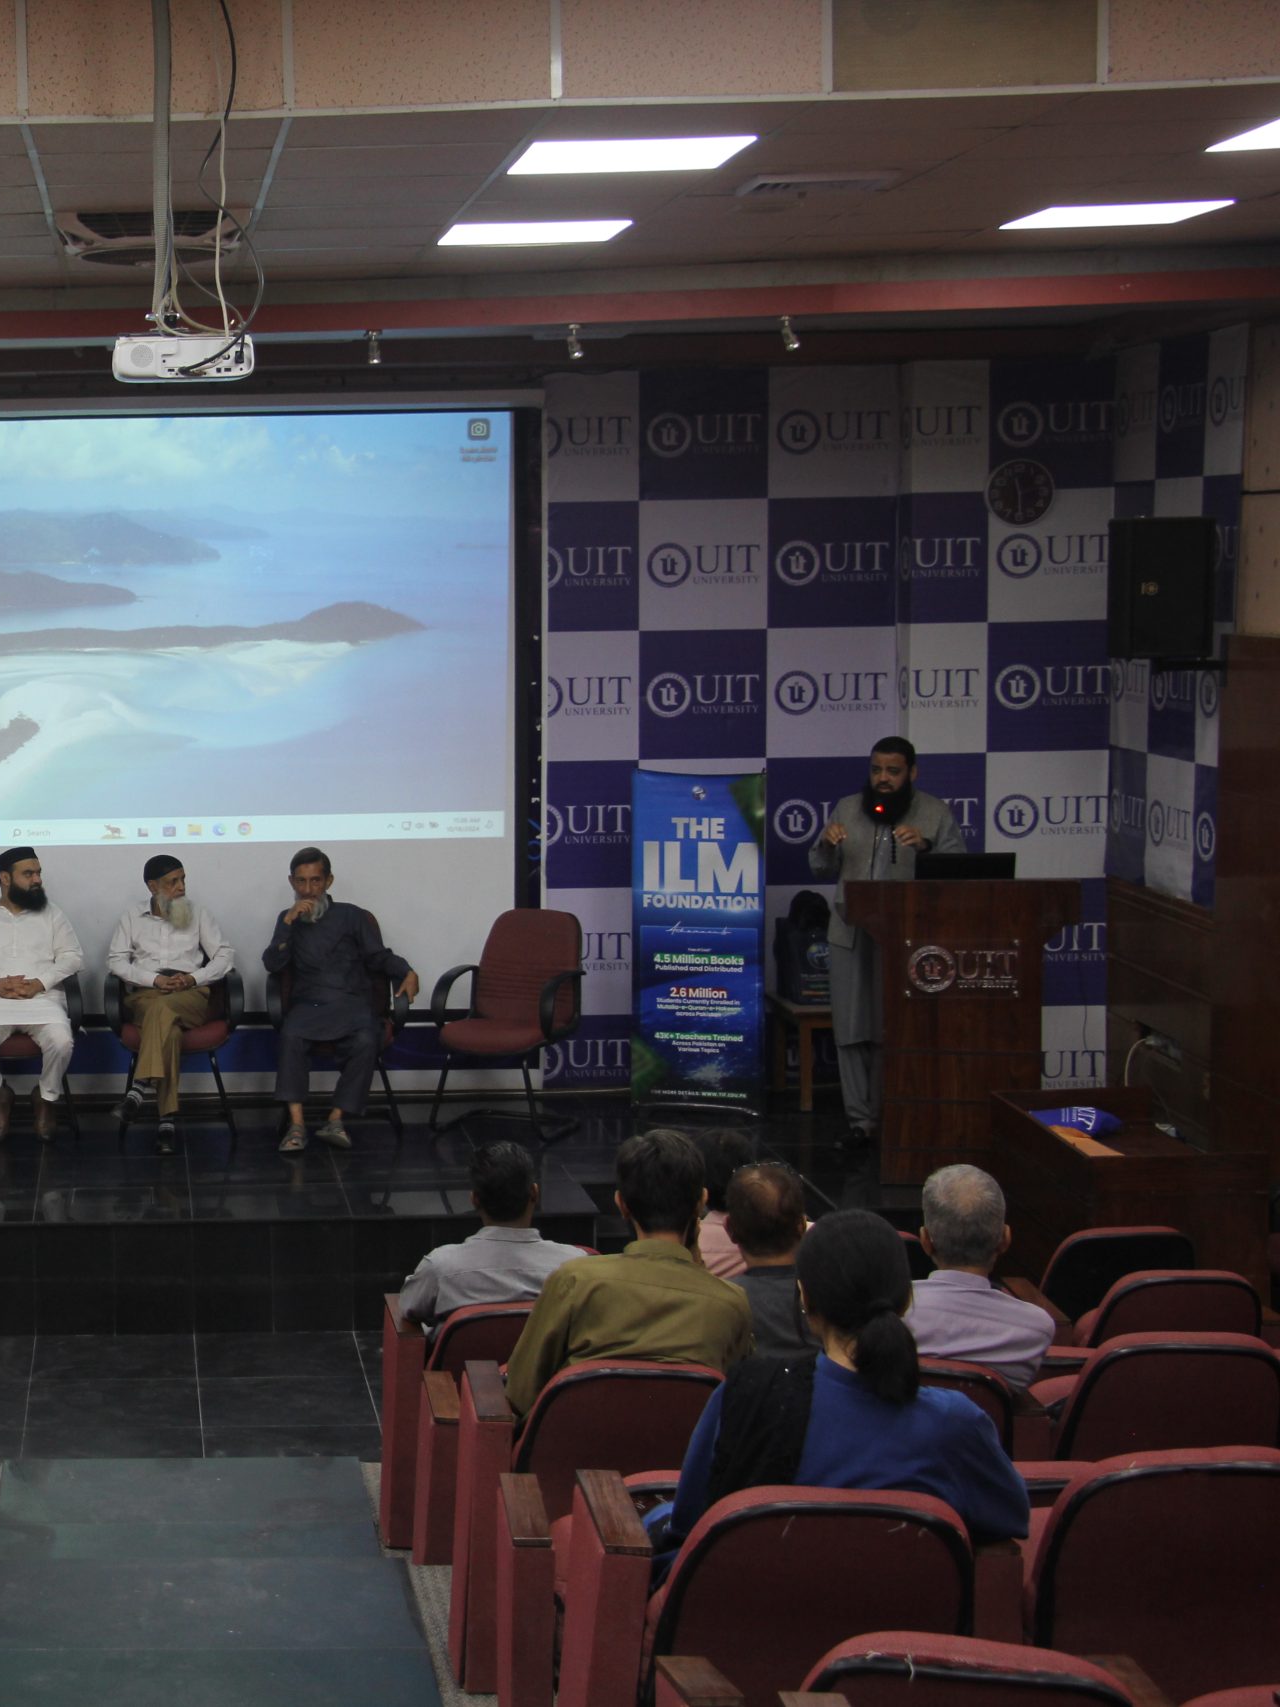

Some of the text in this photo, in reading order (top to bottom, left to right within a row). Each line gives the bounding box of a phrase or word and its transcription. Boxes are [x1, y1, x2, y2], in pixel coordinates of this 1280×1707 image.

[564, 416, 631, 446] UIT
[694, 414, 760, 443] UIT
[824, 411, 890, 440] UIT
[912, 406, 981, 436] UIT
[1044, 402, 1117, 432] UIT
[564, 547, 631, 575] UIT
[694, 545, 760, 573] UIT
[822, 542, 889, 571] UIT
[912, 538, 981, 567] UIT
[564, 577, 631, 586] UNIVERSITY
[693, 575, 760, 584] UNIVERSITY
[821, 573, 888, 582] UNIVERSITY
[912, 568, 981, 578] UNIVERSITY
[565, 677, 631, 705] UIT
[693, 674, 760, 703] UIT
[822, 672, 888, 701] UIT
[912, 668, 980, 698] UIT
[1043, 665, 1112, 695] UIT
[564, 707, 632, 716] UNIVERSITY
[692, 705, 759, 714] UNIVERSITY
[820, 703, 887, 712] UNIVERSITY
[911, 700, 979, 709] UNIVERSITY
[1042, 697, 1112, 706] UNIVERSITY
[564, 805, 631, 834] UIT
[1042, 796, 1109, 824] UIT
[26, 828, 51, 838] Search
[564, 835, 631, 845] UNIVERSITY
[671, 817, 725, 840] THE
[1040, 826, 1109, 836] UNIVERSITY
[643, 841, 759, 894] ILM
[643, 894, 759, 910] FOUNDATION
[653, 953, 744, 966] 4.5 Million Books
[654, 964, 688, 972] Published
[704, 965, 743, 973] Distributed
[954, 950, 1018, 979] UIT
[669, 987, 728, 998] 2.6 Million
[675, 1032, 712, 1041] Teachers
[713, 1033, 744, 1042] Trained
[568, 1040, 631, 1068] UIT
[1041, 1050, 1105, 1078] UIT
[565, 1069, 631, 1079] UNIVERSITY
